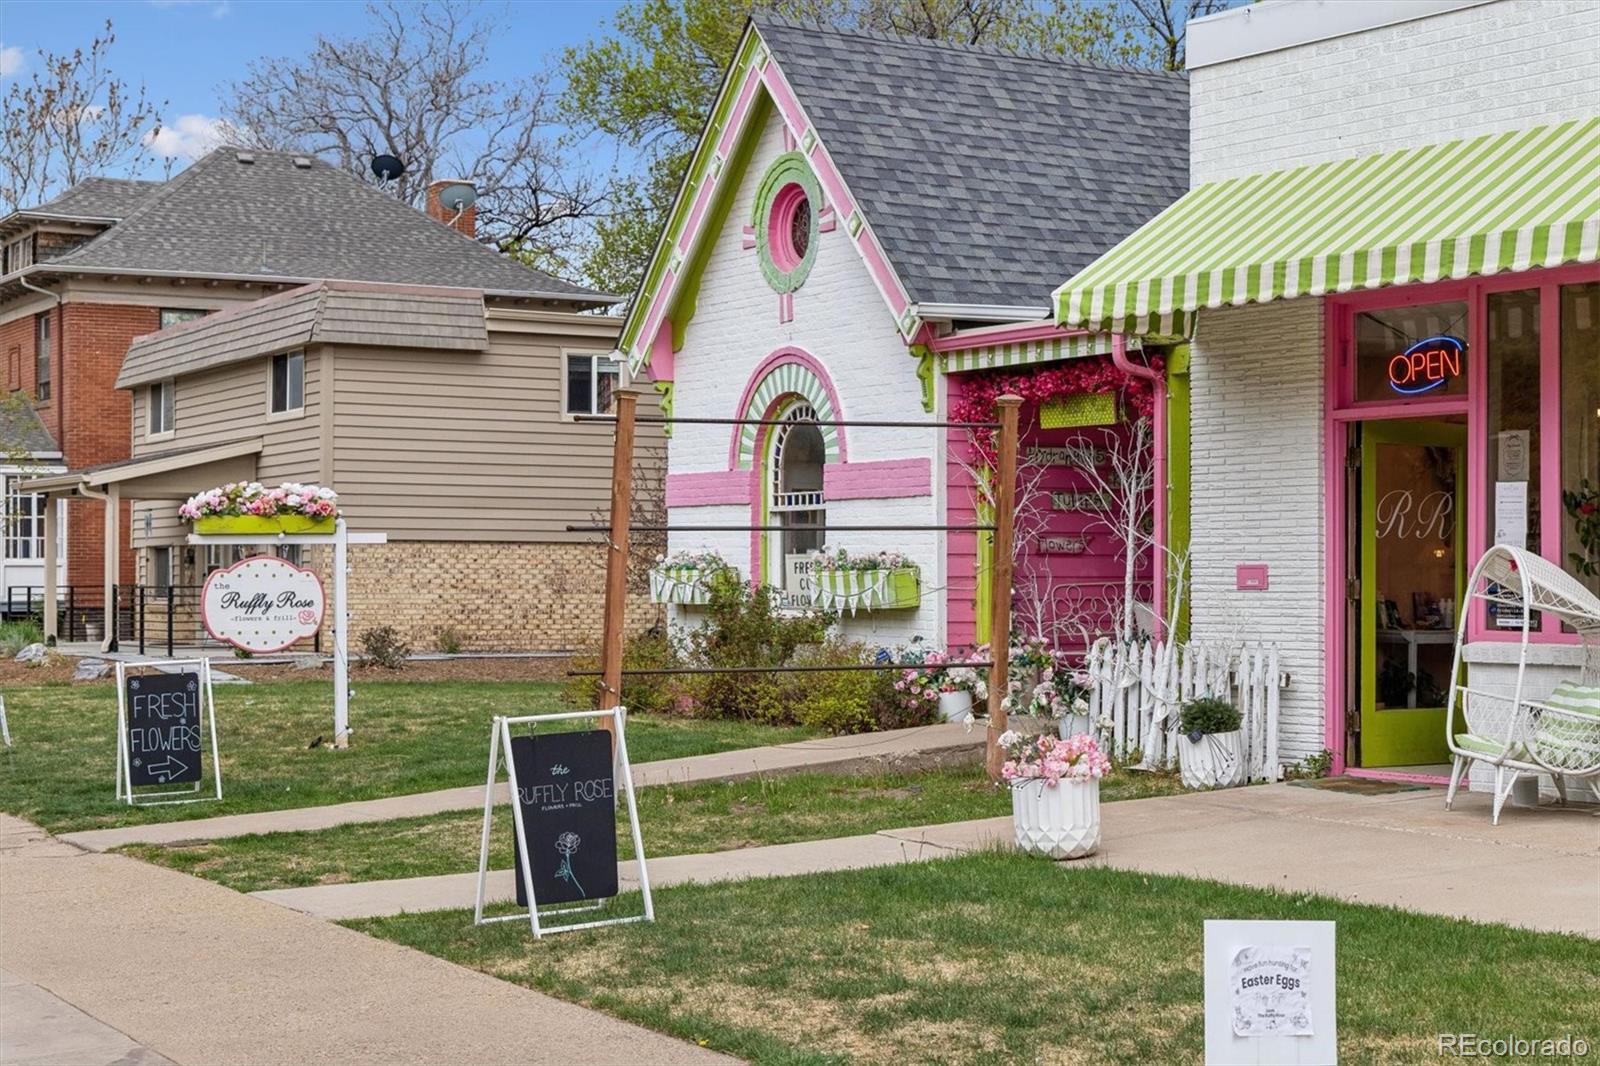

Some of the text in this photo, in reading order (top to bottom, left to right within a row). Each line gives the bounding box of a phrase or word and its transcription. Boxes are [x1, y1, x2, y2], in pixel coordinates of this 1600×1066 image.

[1388, 348, 1460, 385] OPEN
[213, 582, 231, 590] the
[220, 590, 315, 615] Ruffly Rose
[133, 691, 197, 720] FRESH
[130, 724, 201, 753] FLOWERS
[549, 763, 571, 776] the
[518, 777, 613, 805] RUFFLY ROSE
[1241, 973, 1301, 991] Easter Eggs
